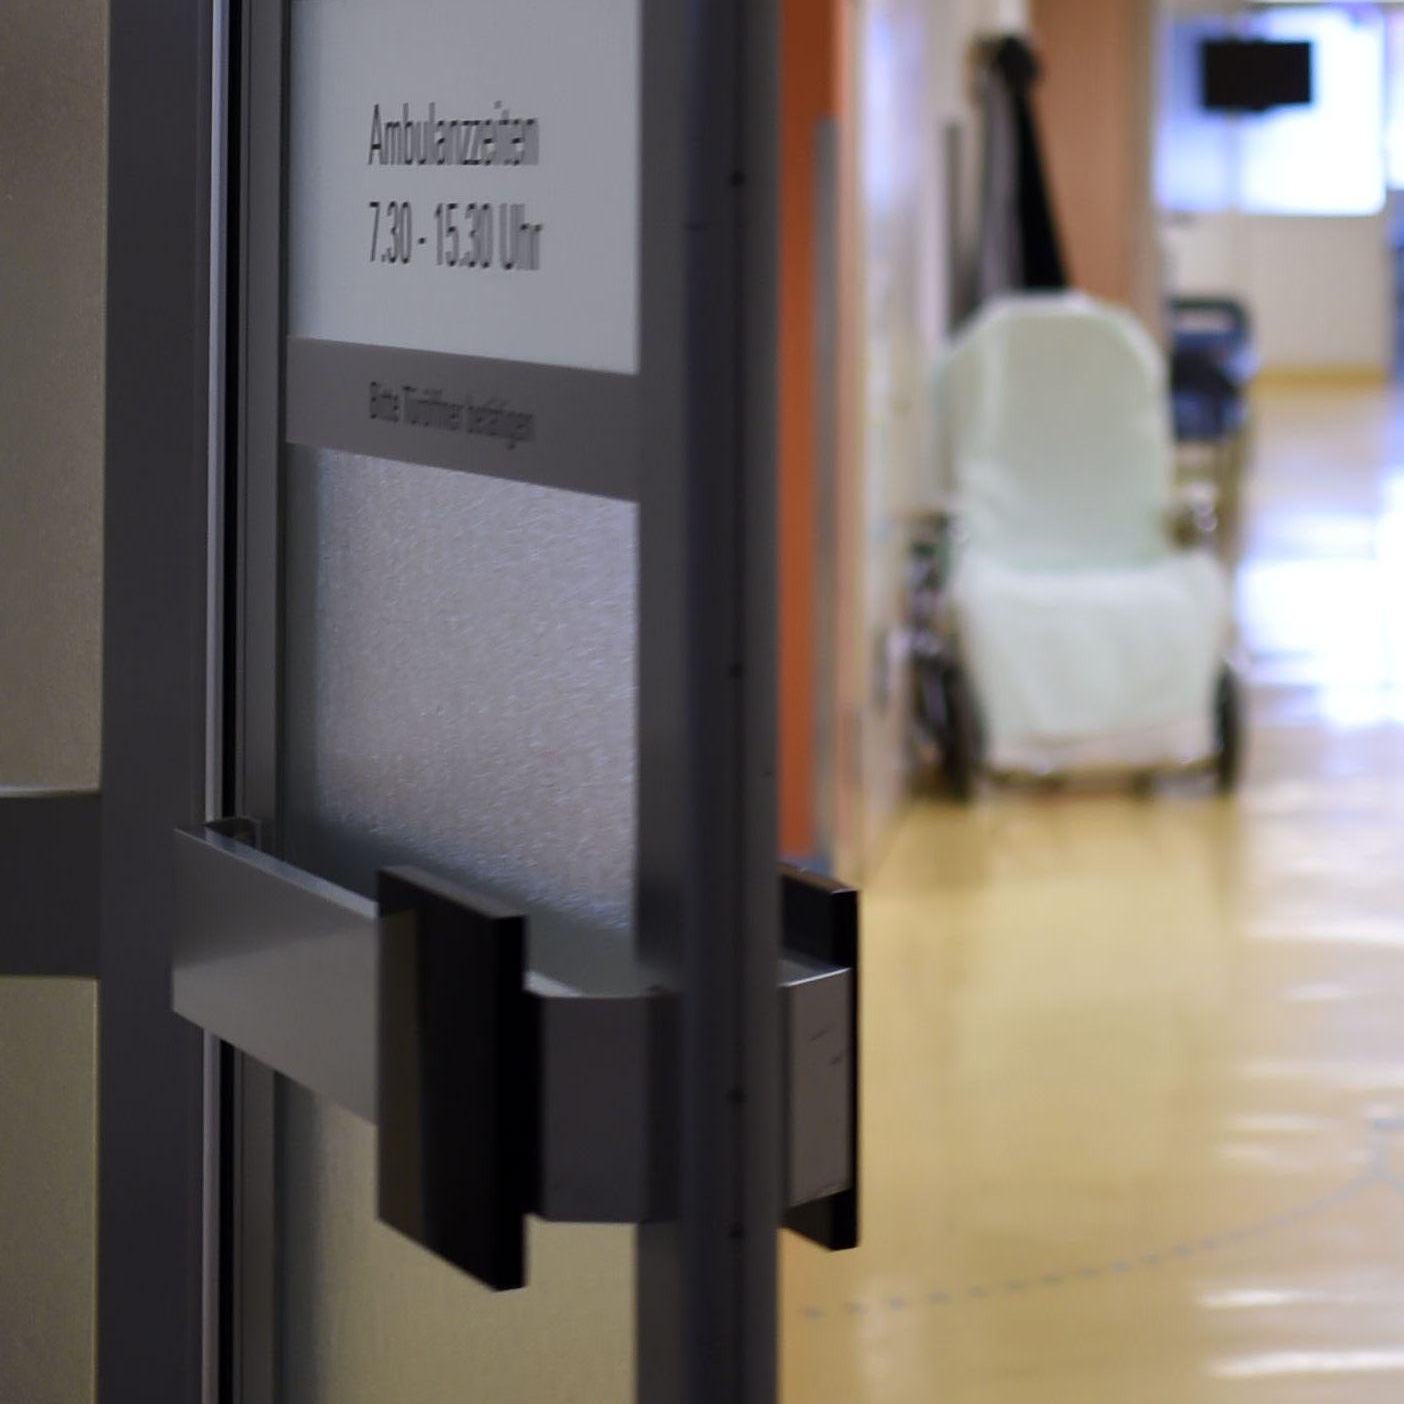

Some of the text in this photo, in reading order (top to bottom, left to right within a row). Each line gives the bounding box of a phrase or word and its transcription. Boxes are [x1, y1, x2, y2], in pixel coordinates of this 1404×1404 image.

[369, 101, 540, 166] Ambulanzzeiten
[369, 201, 411, 264] 7.30
[434, 202, 493, 269] 15.30
[498, 203, 543, 271] Uhr
